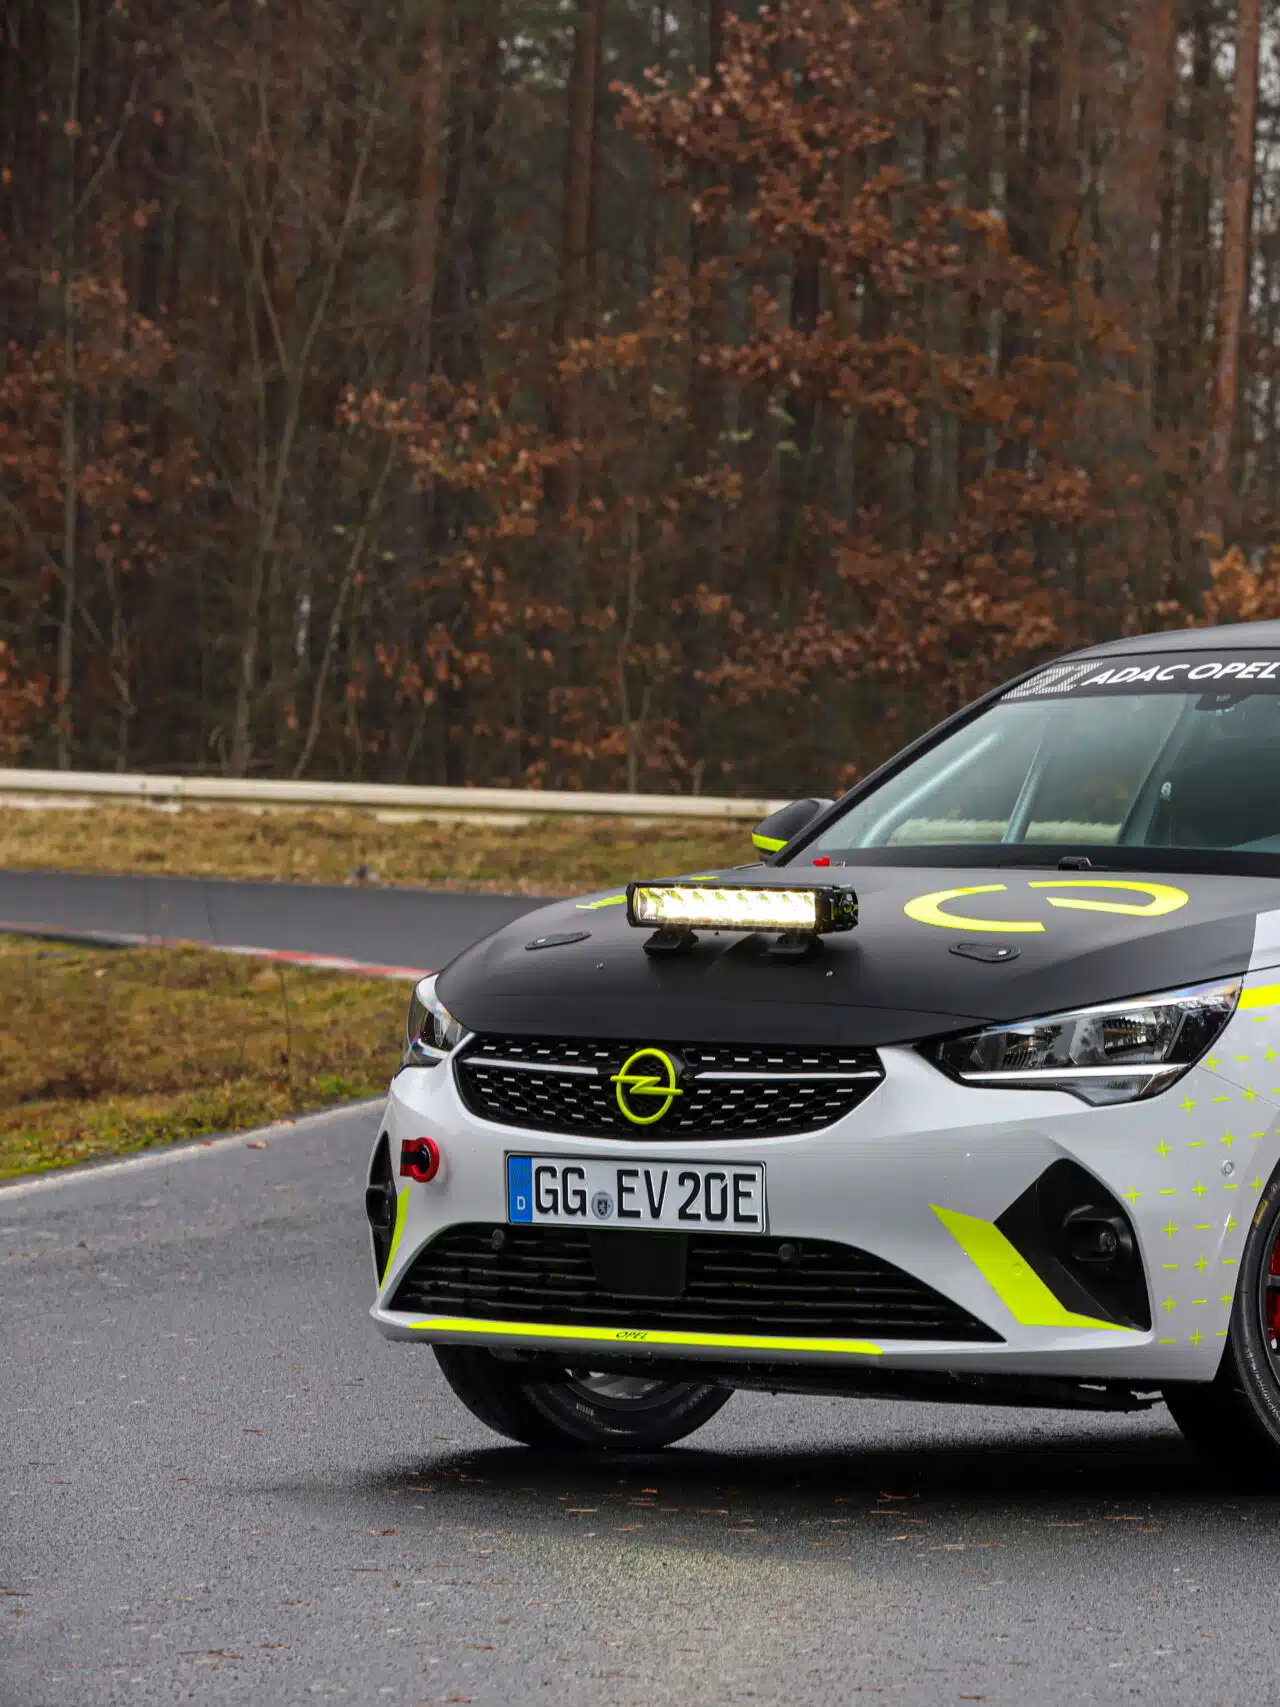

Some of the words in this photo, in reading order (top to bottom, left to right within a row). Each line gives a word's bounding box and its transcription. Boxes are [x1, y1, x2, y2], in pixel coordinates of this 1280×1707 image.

[1081, 664, 1190, 686] ADAC
[1187, 662, 1280, 680] OPEL
[516, 1195, 526, 1211] D
[534, 1165, 588, 1217] GG
[616, 1168, 669, 1219] EV
[678, 1171, 760, 1223] 20E
